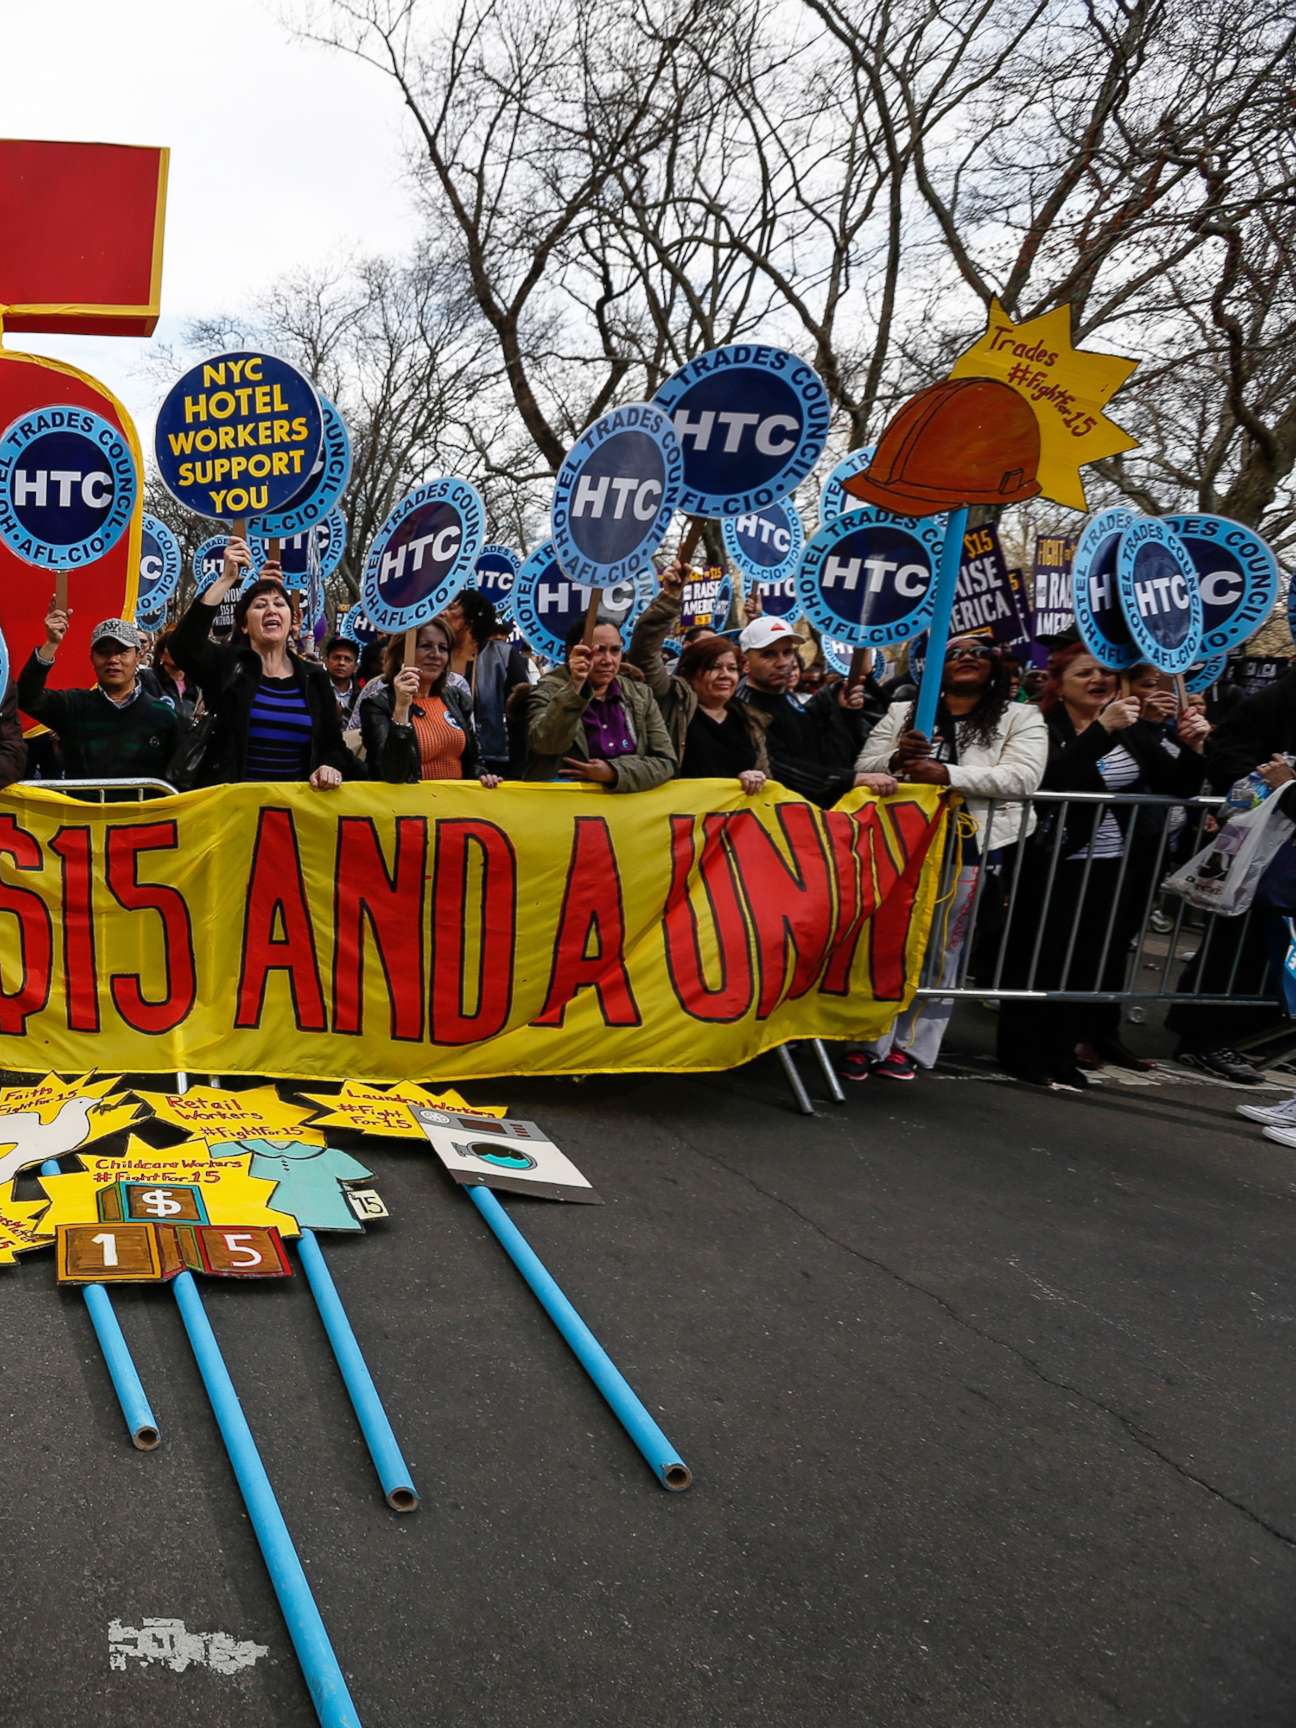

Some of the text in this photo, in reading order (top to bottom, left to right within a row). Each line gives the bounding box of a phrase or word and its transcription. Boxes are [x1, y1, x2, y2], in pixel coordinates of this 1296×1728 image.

[989, 326, 1059, 367] Trades
[203, 358, 263, 388] NYC
[184, 384, 289, 423] HOTEL
[1008, 362, 1098, 437] #FightFor15
[8, 412, 95, 449] TRADES
[168, 417, 309, 456] WORKERS
[324, 409, 344, 493] OUNCIL
[672, 347, 828, 516] TRADES COUNCIL FL-CIO
[673, 409, 800, 456] HTC
[14, 469, 113, 508] HTC
[98, 430, 132, 529] COUNCIL
[178, 450, 304, 486] SUPPORT
[209, 486, 269, 513] YOU
[553, 407, 683, 585] HOTEL TRADES COUNCIL AFL-CIO
[571, 475, 663, 521] HTC
[824, 477, 843, 522] OTEL
[248, 505, 319, 532] FL-CIO
[736, 514, 791, 552] HTC
[17, 538, 104, 564] AFL-CIO
[364, 481, 481, 626] HOTEL TRADES COUNCIL AFL-CIO
[379, 525, 461, 585] HTC
[733, 506, 801, 580] COUNCIL AFL-CIO
[964, 529, 993, 559] $15
[1123, 522, 1164, 560] TRADES
[156, 530, 178, 596] COUNCIL
[800, 511, 920, 643] HOTEL TRADES AFL-CIO
[821, 555, 930, 597] HTC
[1076, 512, 1133, 640] HOTEL TRADES
[1225, 532, 1272, 632] COUNCIL
[519, 573, 539, 637] HOTEL
[1135, 575, 1190, 617] HTC
[1168, 537, 1201, 632] COUNCIL
[950, 590, 1012, 634] ERICA
[1121, 575, 1147, 646] HOTEL
[1153, 636, 1197, 668] AFL-CIO
[234, 806, 517, 1046] AND
[528, 815, 643, 1028] A
[4, 1087, 52, 1101] Faith
[166, 1095, 241, 1111] Retail
[337, 1103, 402, 1119] #Fight
[347, 1089, 496, 1119] Laundry Workers
[176, 1110, 263, 1121] Workers
[95, 1159, 243, 1169] Childcare Workers
[142, 1189, 181, 1217] $
[91, 1233, 263, 1266] 1 5
